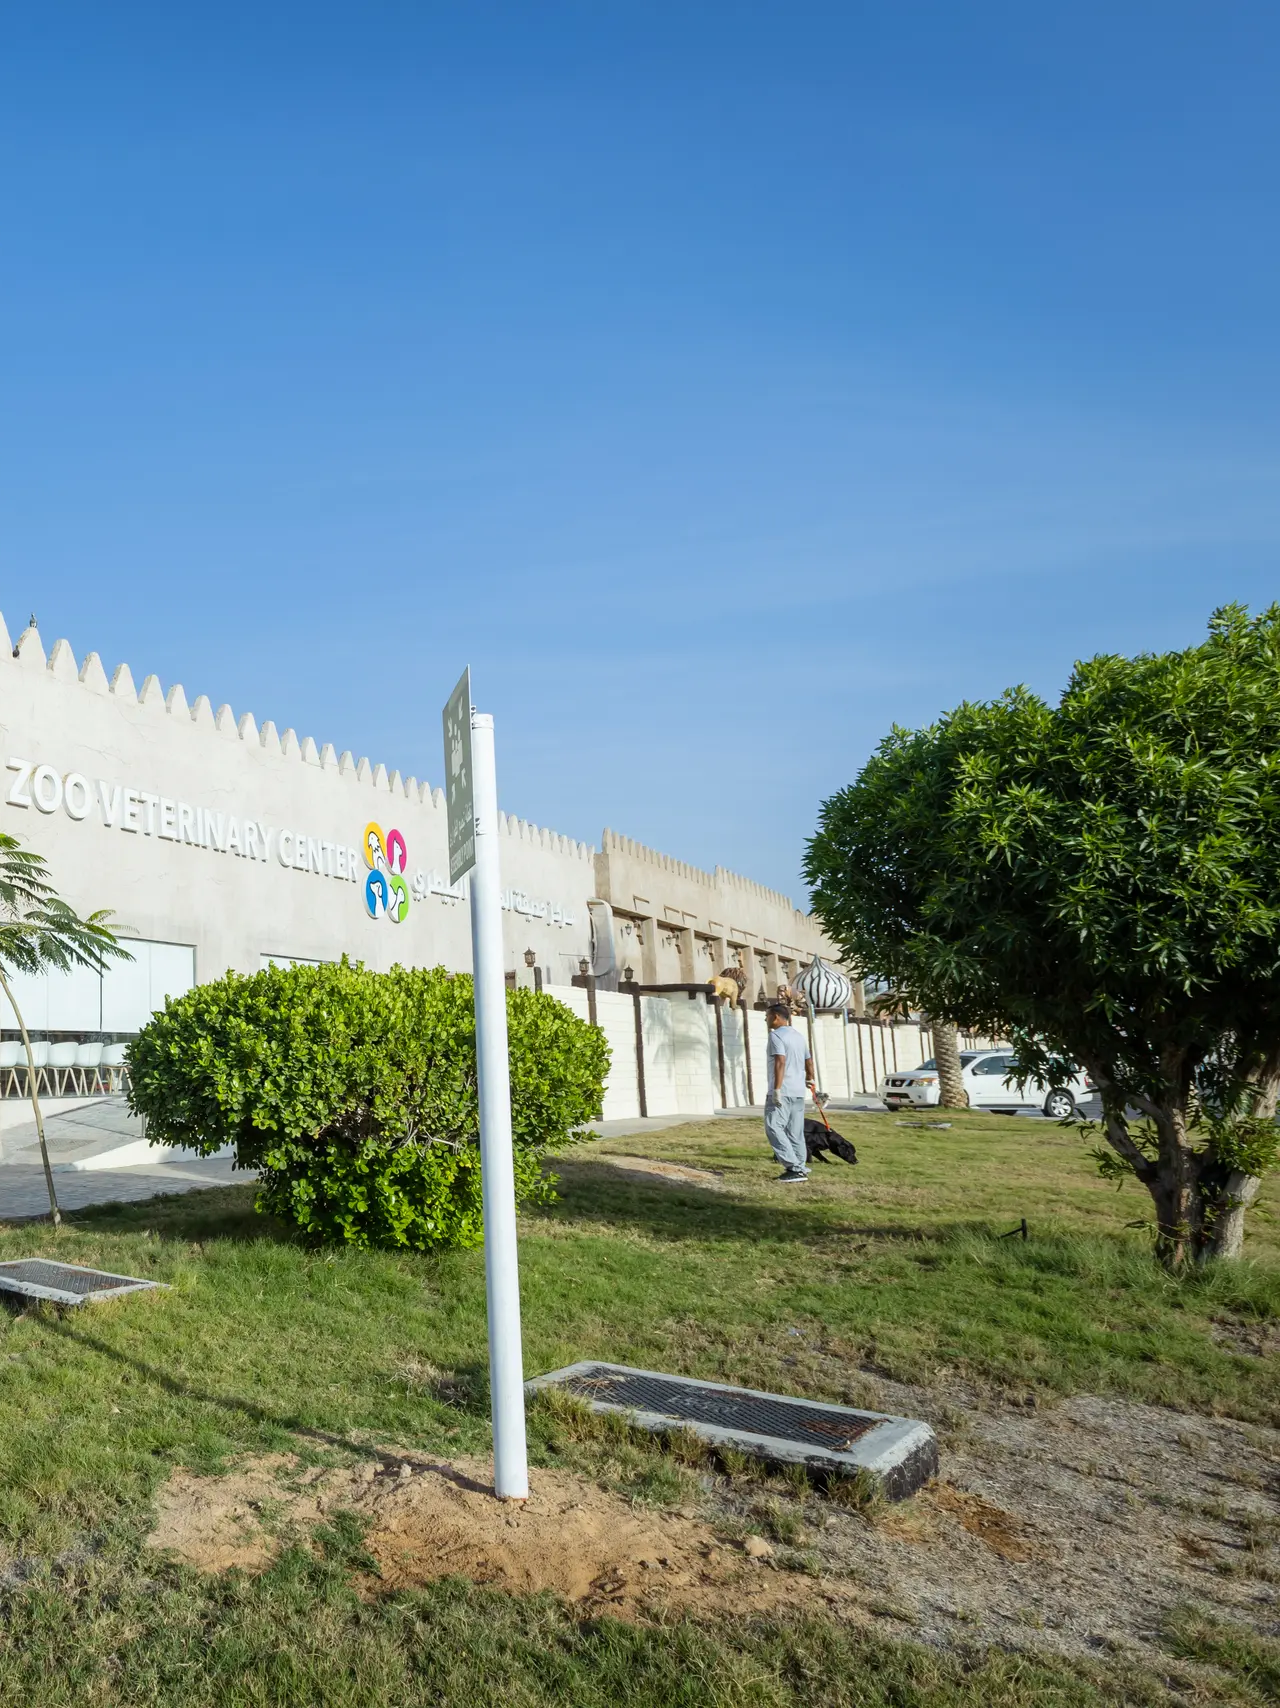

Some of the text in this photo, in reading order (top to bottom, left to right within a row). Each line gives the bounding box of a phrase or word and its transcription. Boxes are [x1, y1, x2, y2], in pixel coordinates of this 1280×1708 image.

[5, 756, 359, 883] ZOO VETERINARY CENTER
